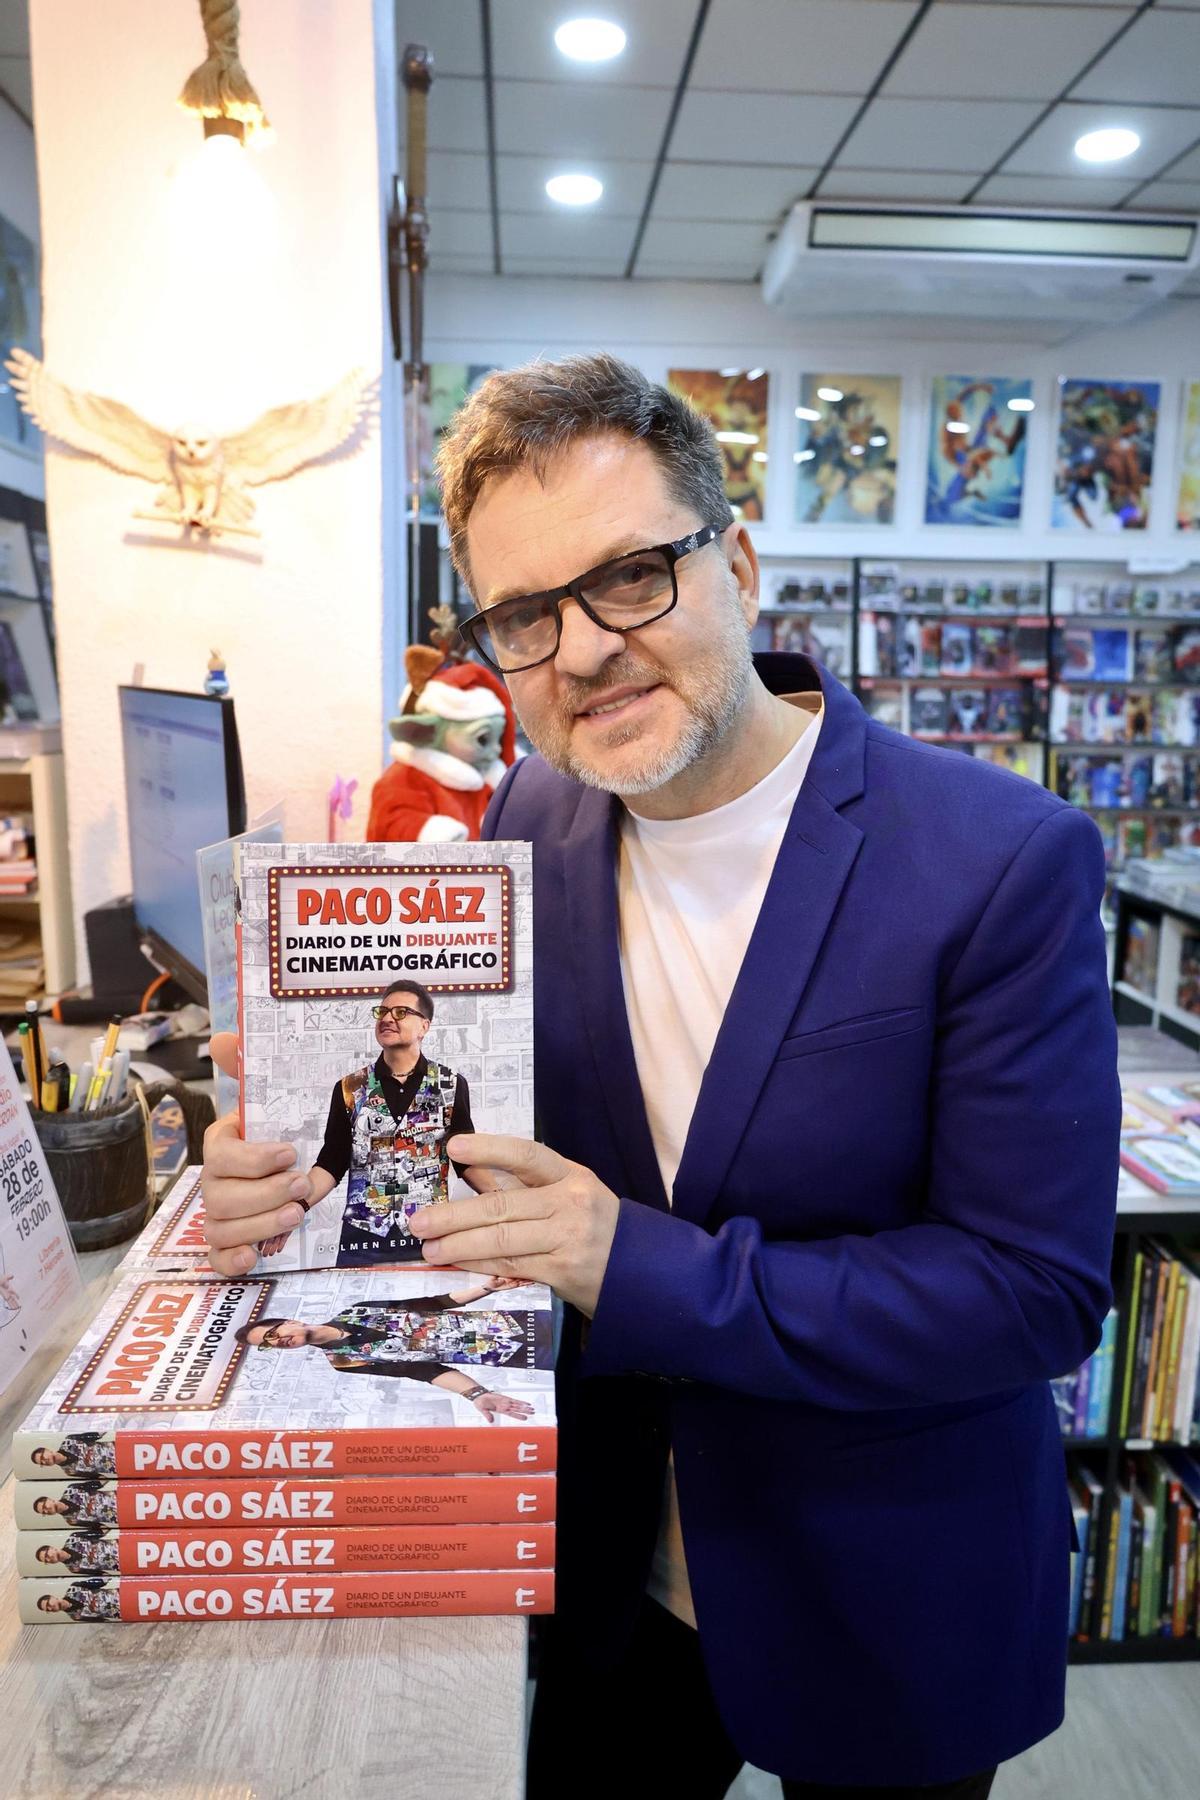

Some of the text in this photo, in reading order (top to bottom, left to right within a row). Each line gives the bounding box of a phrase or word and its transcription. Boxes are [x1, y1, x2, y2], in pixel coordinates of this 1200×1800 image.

[298, 879, 485, 926] PACO SÁEZ
[286, 932, 498, 950] DIARIO DE UN DIBUJANTE
[286, 948, 498, 974] CINEMATOGRÁFICO
[2, 1160, 39, 1203] 28 de
[10, 1179, 44, 1219] FEBRERO
[16, 1199, 52, 1241] 19:00h
[318, 1241, 380, 1253] DOLMEN
[95, 1293, 194, 1396] PACO SÁEZ
[149, 1287, 221, 1402] DIARIO DE UN DIBUJANTE
[175, 1287, 245, 1402] CINEMATOGRÁFICO
[134, 1432, 334, 1471] PACO SÁEZ
[346, 1445, 468, 1455] DIARIO DE UN DIBUJANTE
[135, 1480, 334, 1520] PACO SÁEZ
[346, 1496, 379, 1504] DIARIO
[397, 1495, 413, 1504] UN
[415, 1495, 468, 1504] DIBUJANTE
[137, 1528, 335, 1568] PACO SÁEZ
[346, 1544, 379, 1552] DIARIO
[397, 1543, 413, 1552] UN
[415, 1543, 468, 1552] DIBUJANTE
[138, 1579, 334, 1616] PACO SÁEZ
[346, 1591, 468, 1601] DIARIO DE UN DIBUJANTE
